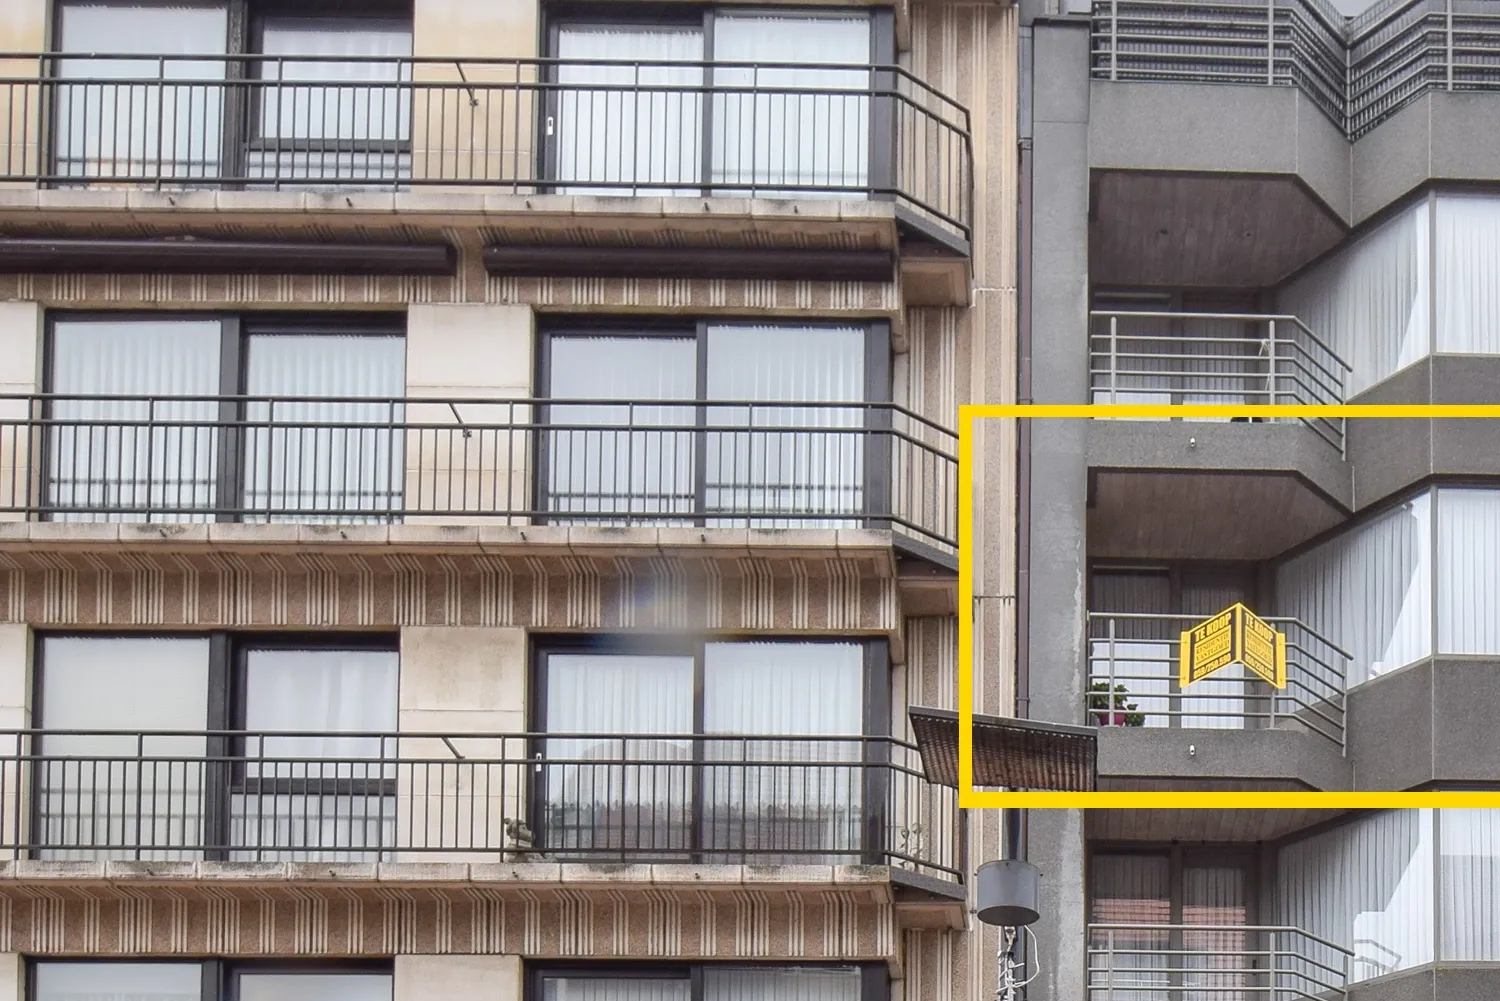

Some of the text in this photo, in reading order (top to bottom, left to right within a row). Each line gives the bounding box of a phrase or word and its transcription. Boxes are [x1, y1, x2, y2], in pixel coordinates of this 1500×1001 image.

[1195, 613, 1232, 642] TE KOOP
[1245, 612, 1273, 642] TE KOOP
